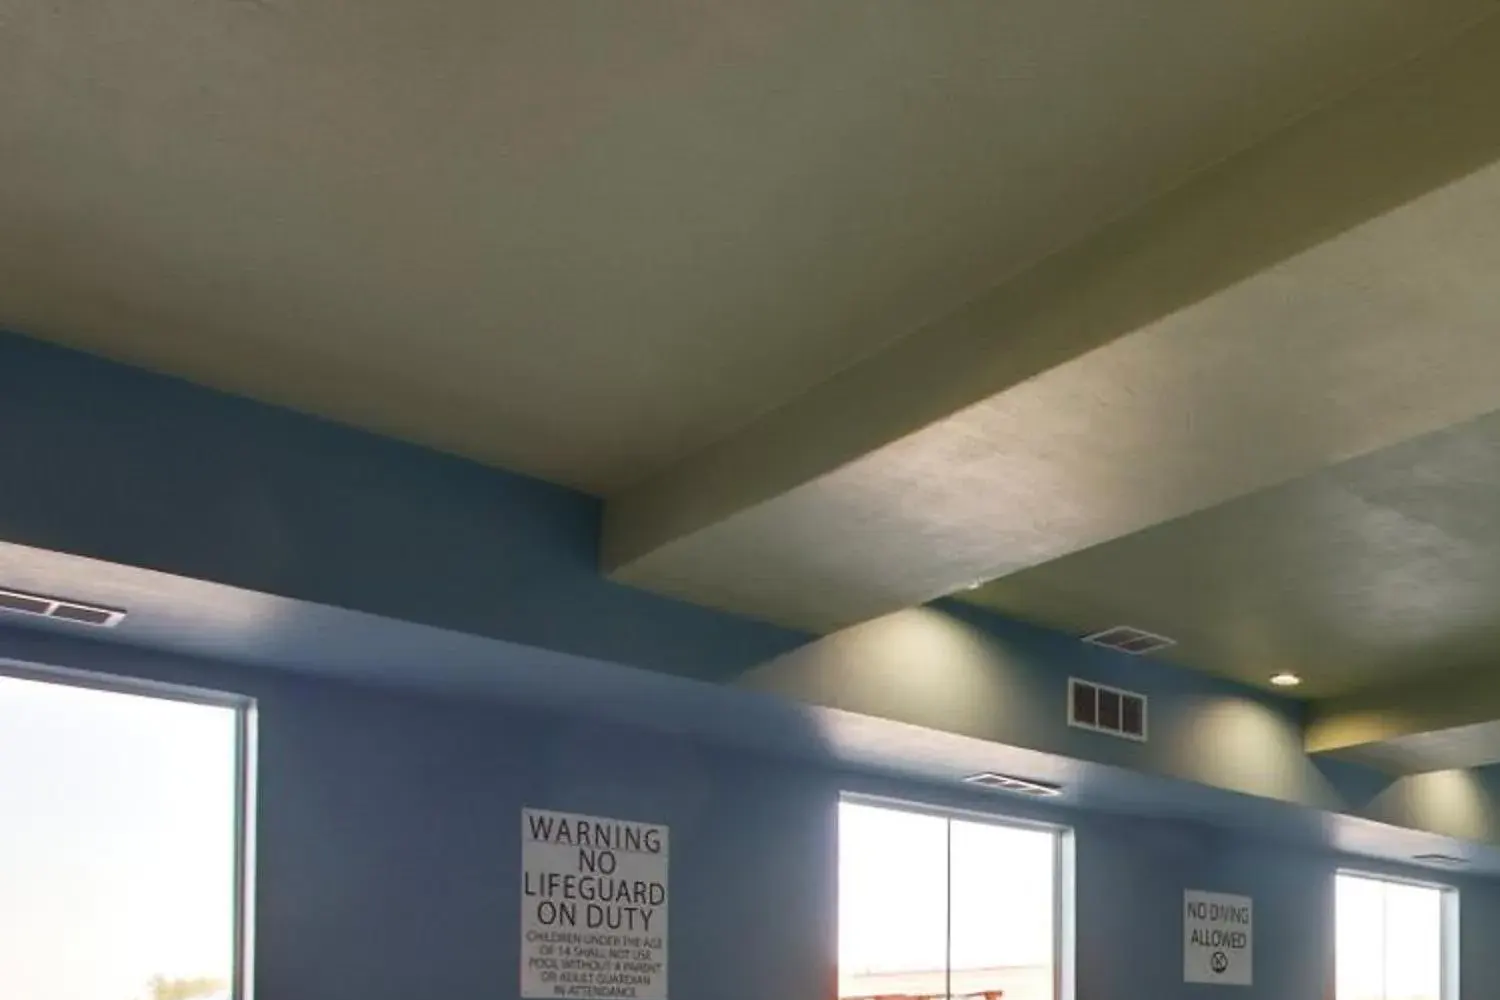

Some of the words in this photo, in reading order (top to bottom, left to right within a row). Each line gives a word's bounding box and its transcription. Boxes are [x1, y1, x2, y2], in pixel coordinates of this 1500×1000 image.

[529, 815, 661, 854] WARNING
[578, 848, 616, 875] NO
[524, 871, 666, 906] LIFEGUARD
[537, 900, 576, 926] ON
[586, 904, 654, 931] DUTY
[1187, 901, 1207, 920] NO
[1210, 903, 1249, 925] DIVING
[526, 930, 581, 944] CHILDREN
[584, 934, 621, 946] UNDER
[623, 936, 640, 947] THE
[643, 937, 662, 949] AGE
[1190, 928, 1247, 949] ALLOWED
[539, 945, 554, 955] OF
[573, 946, 606, 958] SHALL
[609, 948, 630, 959] NOT
[633, 949, 652, 960] USE
[528, 958, 559, 970] POOL
[561, 959, 612, 971] WITHOUT
[540, 971, 557, 982] OR
